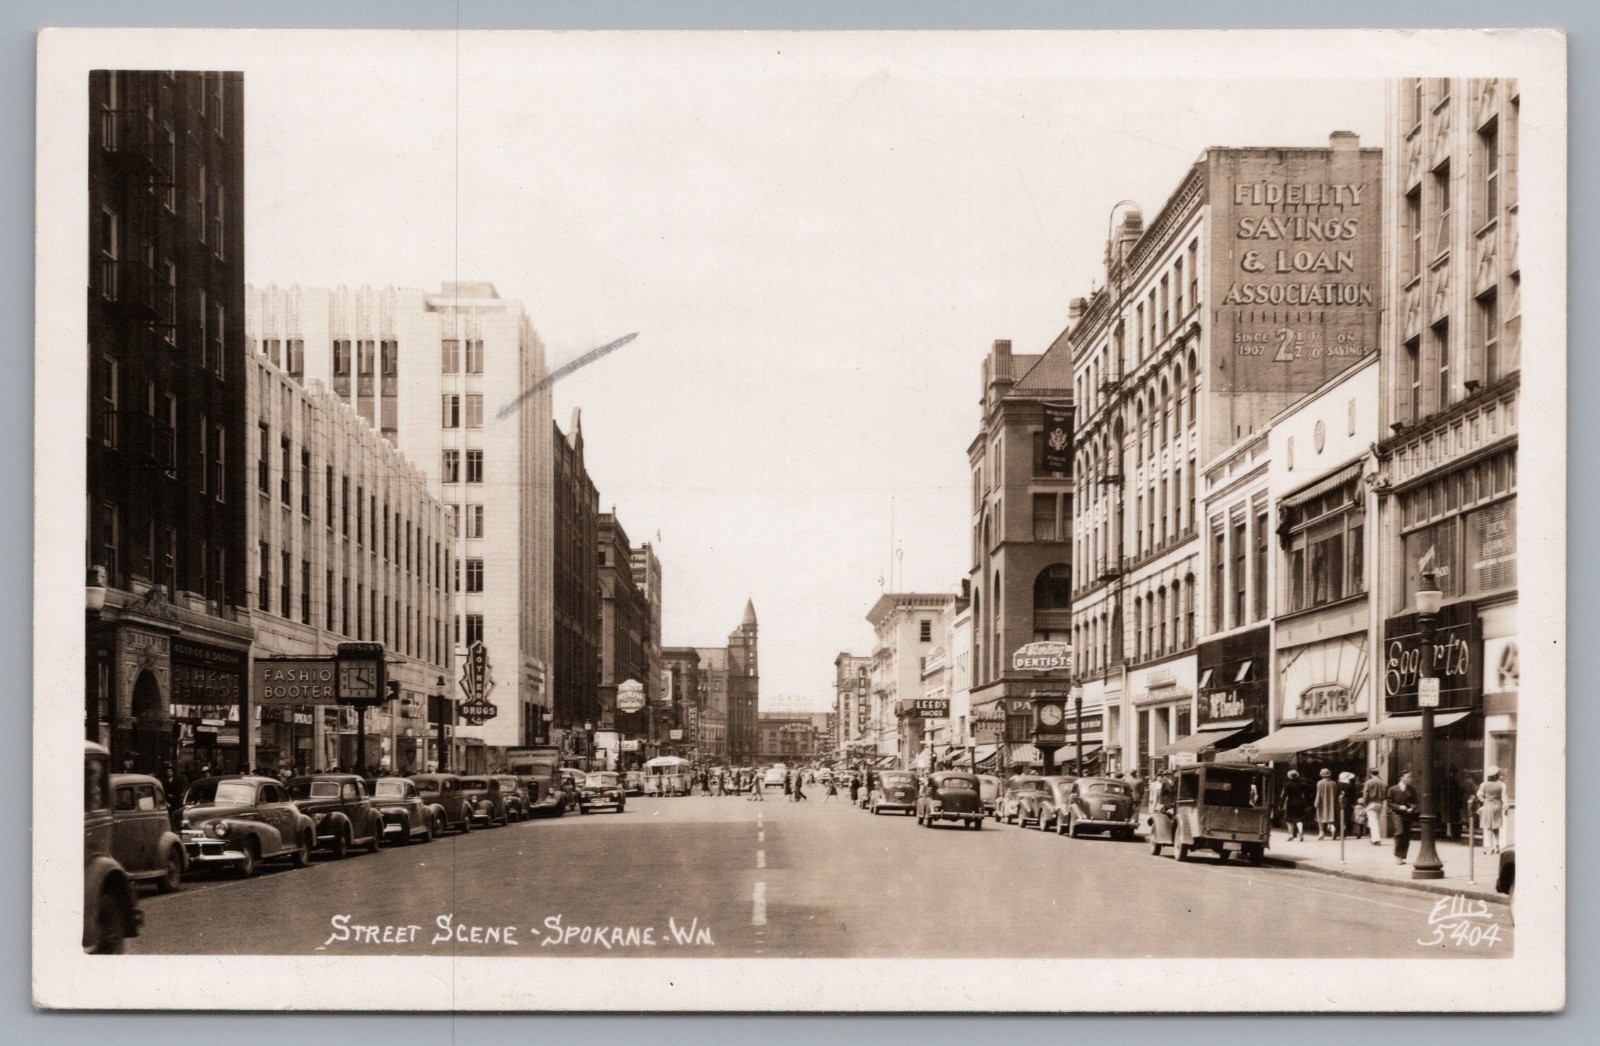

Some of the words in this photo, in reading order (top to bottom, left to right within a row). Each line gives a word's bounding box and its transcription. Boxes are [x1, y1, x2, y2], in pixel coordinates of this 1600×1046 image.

[1234, 183, 1368, 206] FIDELITY
[1237, 216, 1359, 240] SAVINGS
[1242, 250, 1266, 272] &
[1276, 250, 1354, 273] LOAN
[1223, 282, 1373, 306] ASSOCIATION
[1234, 332, 1269, 343] SINCE
[1238, 345, 1265, 355] 1907
[1327, 346, 1369, 356] SAVINGS
[1017, 657, 1073, 667] DENTISTS
[1385, 633, 1469, 696] Eggrt's
[264, 669, 332, 681] FASHIO
[264, 686, 333, 698] BOOTER
[916, 700, 947, 709] LEED'S
[463, 707, 496, 715] DRUGS
